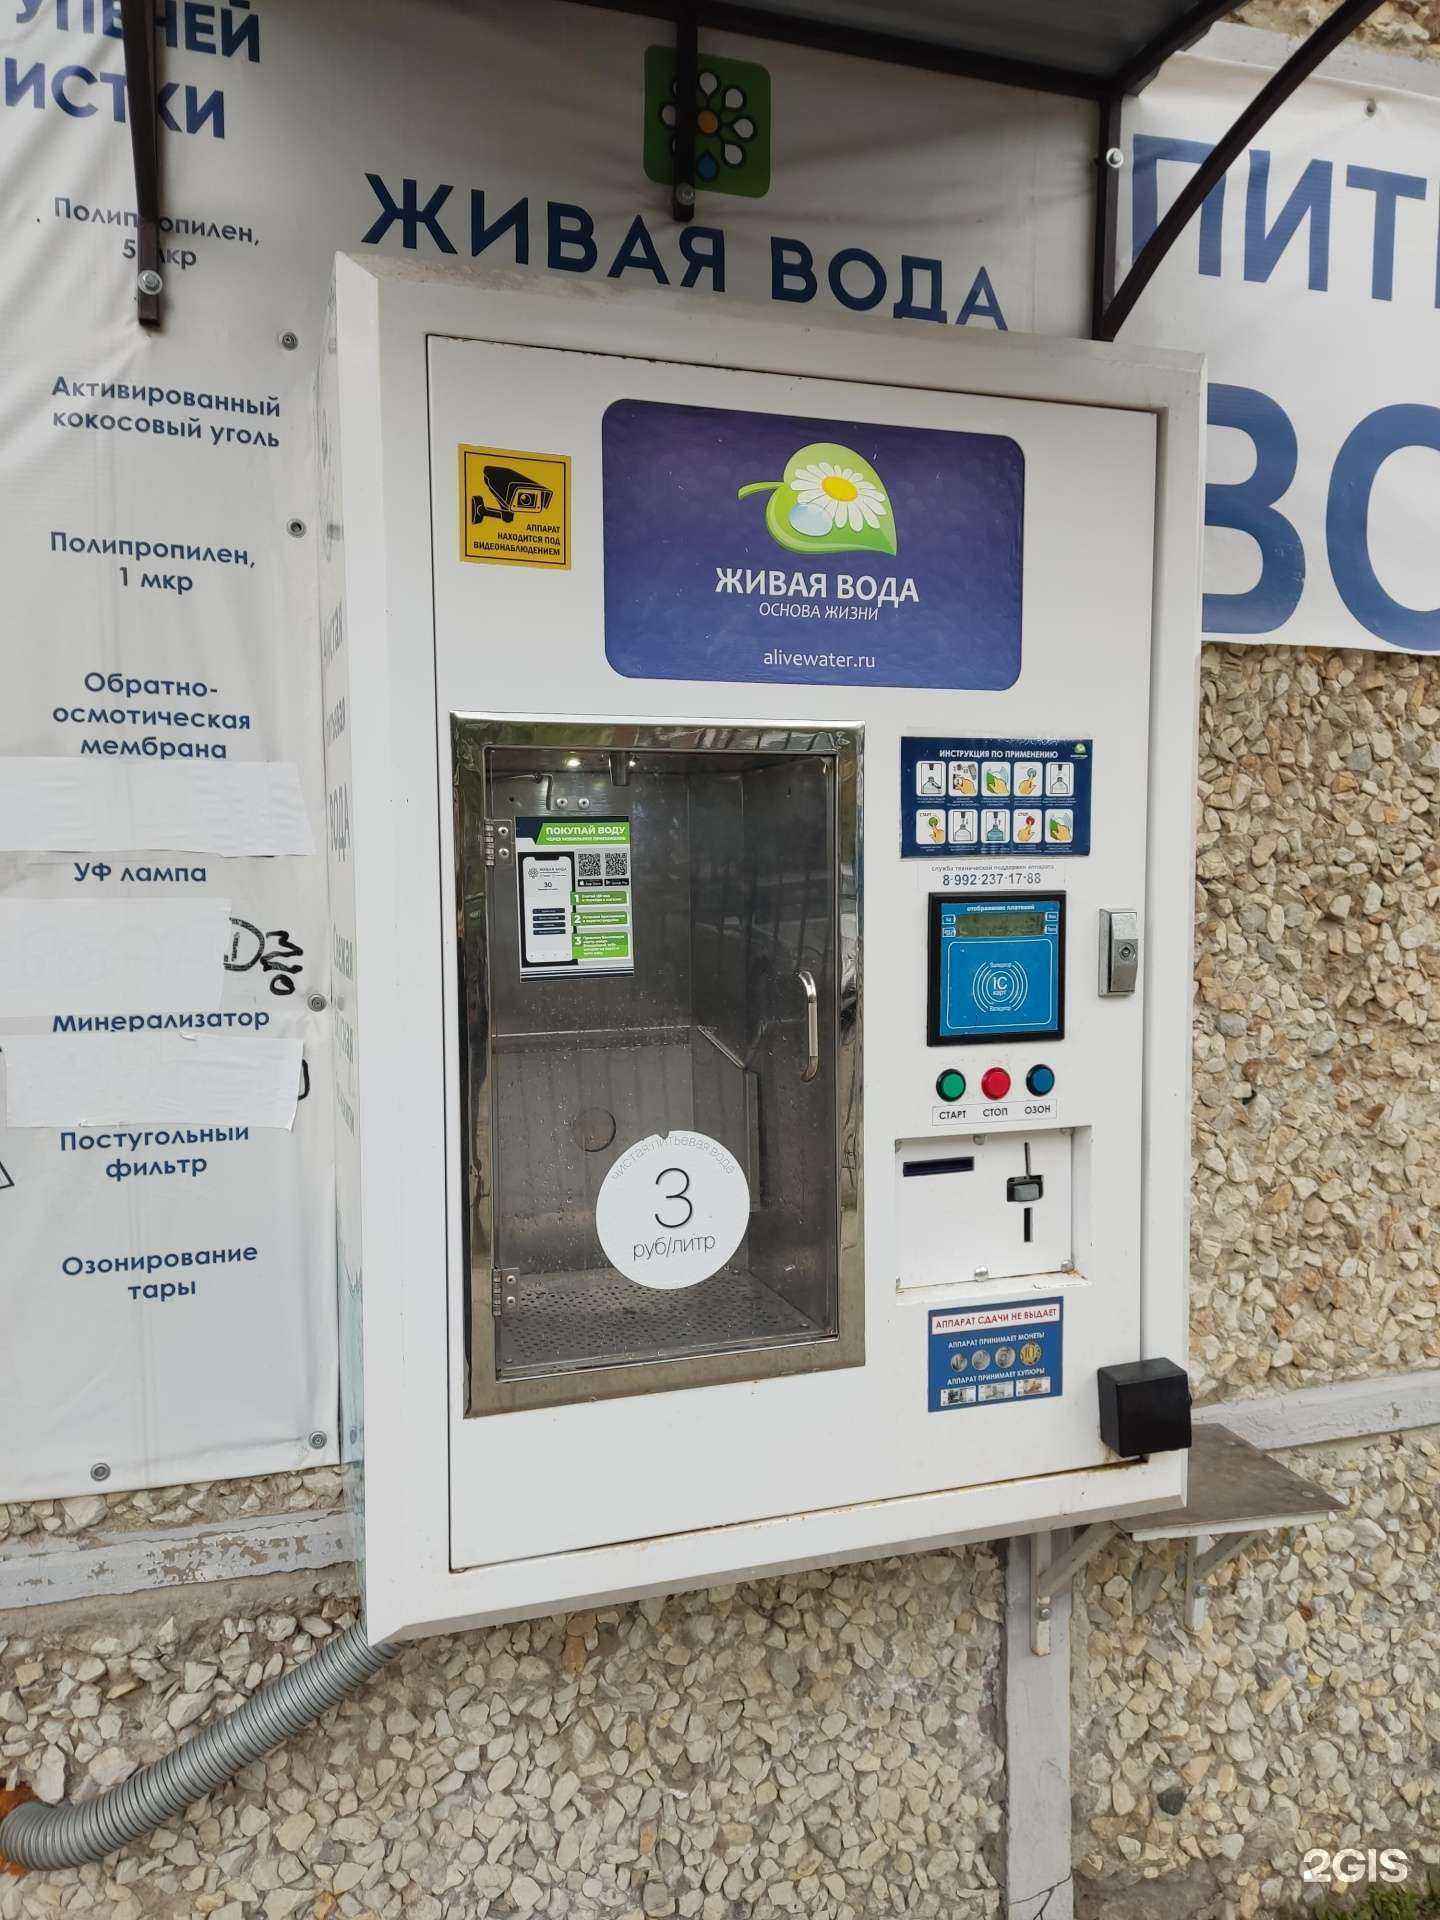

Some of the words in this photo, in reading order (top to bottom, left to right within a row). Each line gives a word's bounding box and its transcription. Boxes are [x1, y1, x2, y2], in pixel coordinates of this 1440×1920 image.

[54, 197, 260, 246] Полипопилен,
[1132, 134, 1440, 309] ПИТ
[122, 238, 136, 259] 5
[361, 173, 725, 292] ЖИВАЯ
[770, 236, 1008, 331] ВОДА
[52, 376, 281, 417] Активированный
[53, 410, 202, 439] кокосовый
[210, 426, 280, 448] уголь
[497, 532, 543, 543] НАХОДИТСЯ
[544, 537, 560, 546] ПОД
[526, 523, 560, 533] АППАРАТ
[50, 531, 256, 569] Полипропилен,
[473, 541, 560, 556] ВИДЕОНАБЛЮДЕНИЕМ
[118, 566, 128, 587] 1
[140, 571, 193, 595] мкр
[715, 567, 827, 598] ЖИВАЯ
[837, 574, 920, 608] ВОДА
[759, 602, 821, 619] ОСНОВА
[825, 606, 879, 621] ЖИЗНИ
[763, 648, 876, 668] alivewater.ru
[84, 671, 218, 697] Обратно-
[53, 707, 250, 730] осмотическая
[81, 737, 227, 760] мембрана
[939, 750, 989, 759] ИНСТРУКЦИЯ
[1005, 751, 1058, 759] ПРИМЕНЕНИЮ
[546, 825, 595, 835] ПОКУПАЙ
[598, 826, 625, 836] ВОДУ
[74, 862, 112, 883] УФ
[121, 864, 207, 884] лампа
[574, 915, 581, 924] 2
[574, 936, 582, 946] 3
[993, 976, 1007, 990] IC
[53, 1010, 270, 1033] Минерализатор
[939, 1110, 966, 1120] СТАРТ
[983, 1107, 1008, 1118] СТОП
[1024, 1104, 1051, 1115] ОЗОН
[60, 1126, 249, 1152] Постугольный
[106, 1157, 207, 1181] фильтр
[655, 1168, 692, 1228] 3
[633, 1235, 716, 1261] руб/литр
[62, 1245, 258, 1276] Озонирование
[128, 1279, 196, 1301] тары
[936, 1317, 975, 1329] АППАРАТ
[978, 1313, 1009, 1324] СДАЧИ
[1012, 1311, 1022, 1320] НЕ
[1024, 1308, 1056, 1319] ВЫДАЕТ
[948, 1340, 979, 1349] АППАРАТ
[980, 1335, 1017, 1345] ПРИНИМАЕТ
[1018, 1331, 1045, 1341] МОНЕТЫ
[947, 1376, 977, 1386] АППАРАТ
[978, 1371, 1016, 1382] ПРИНИМАЕТ
